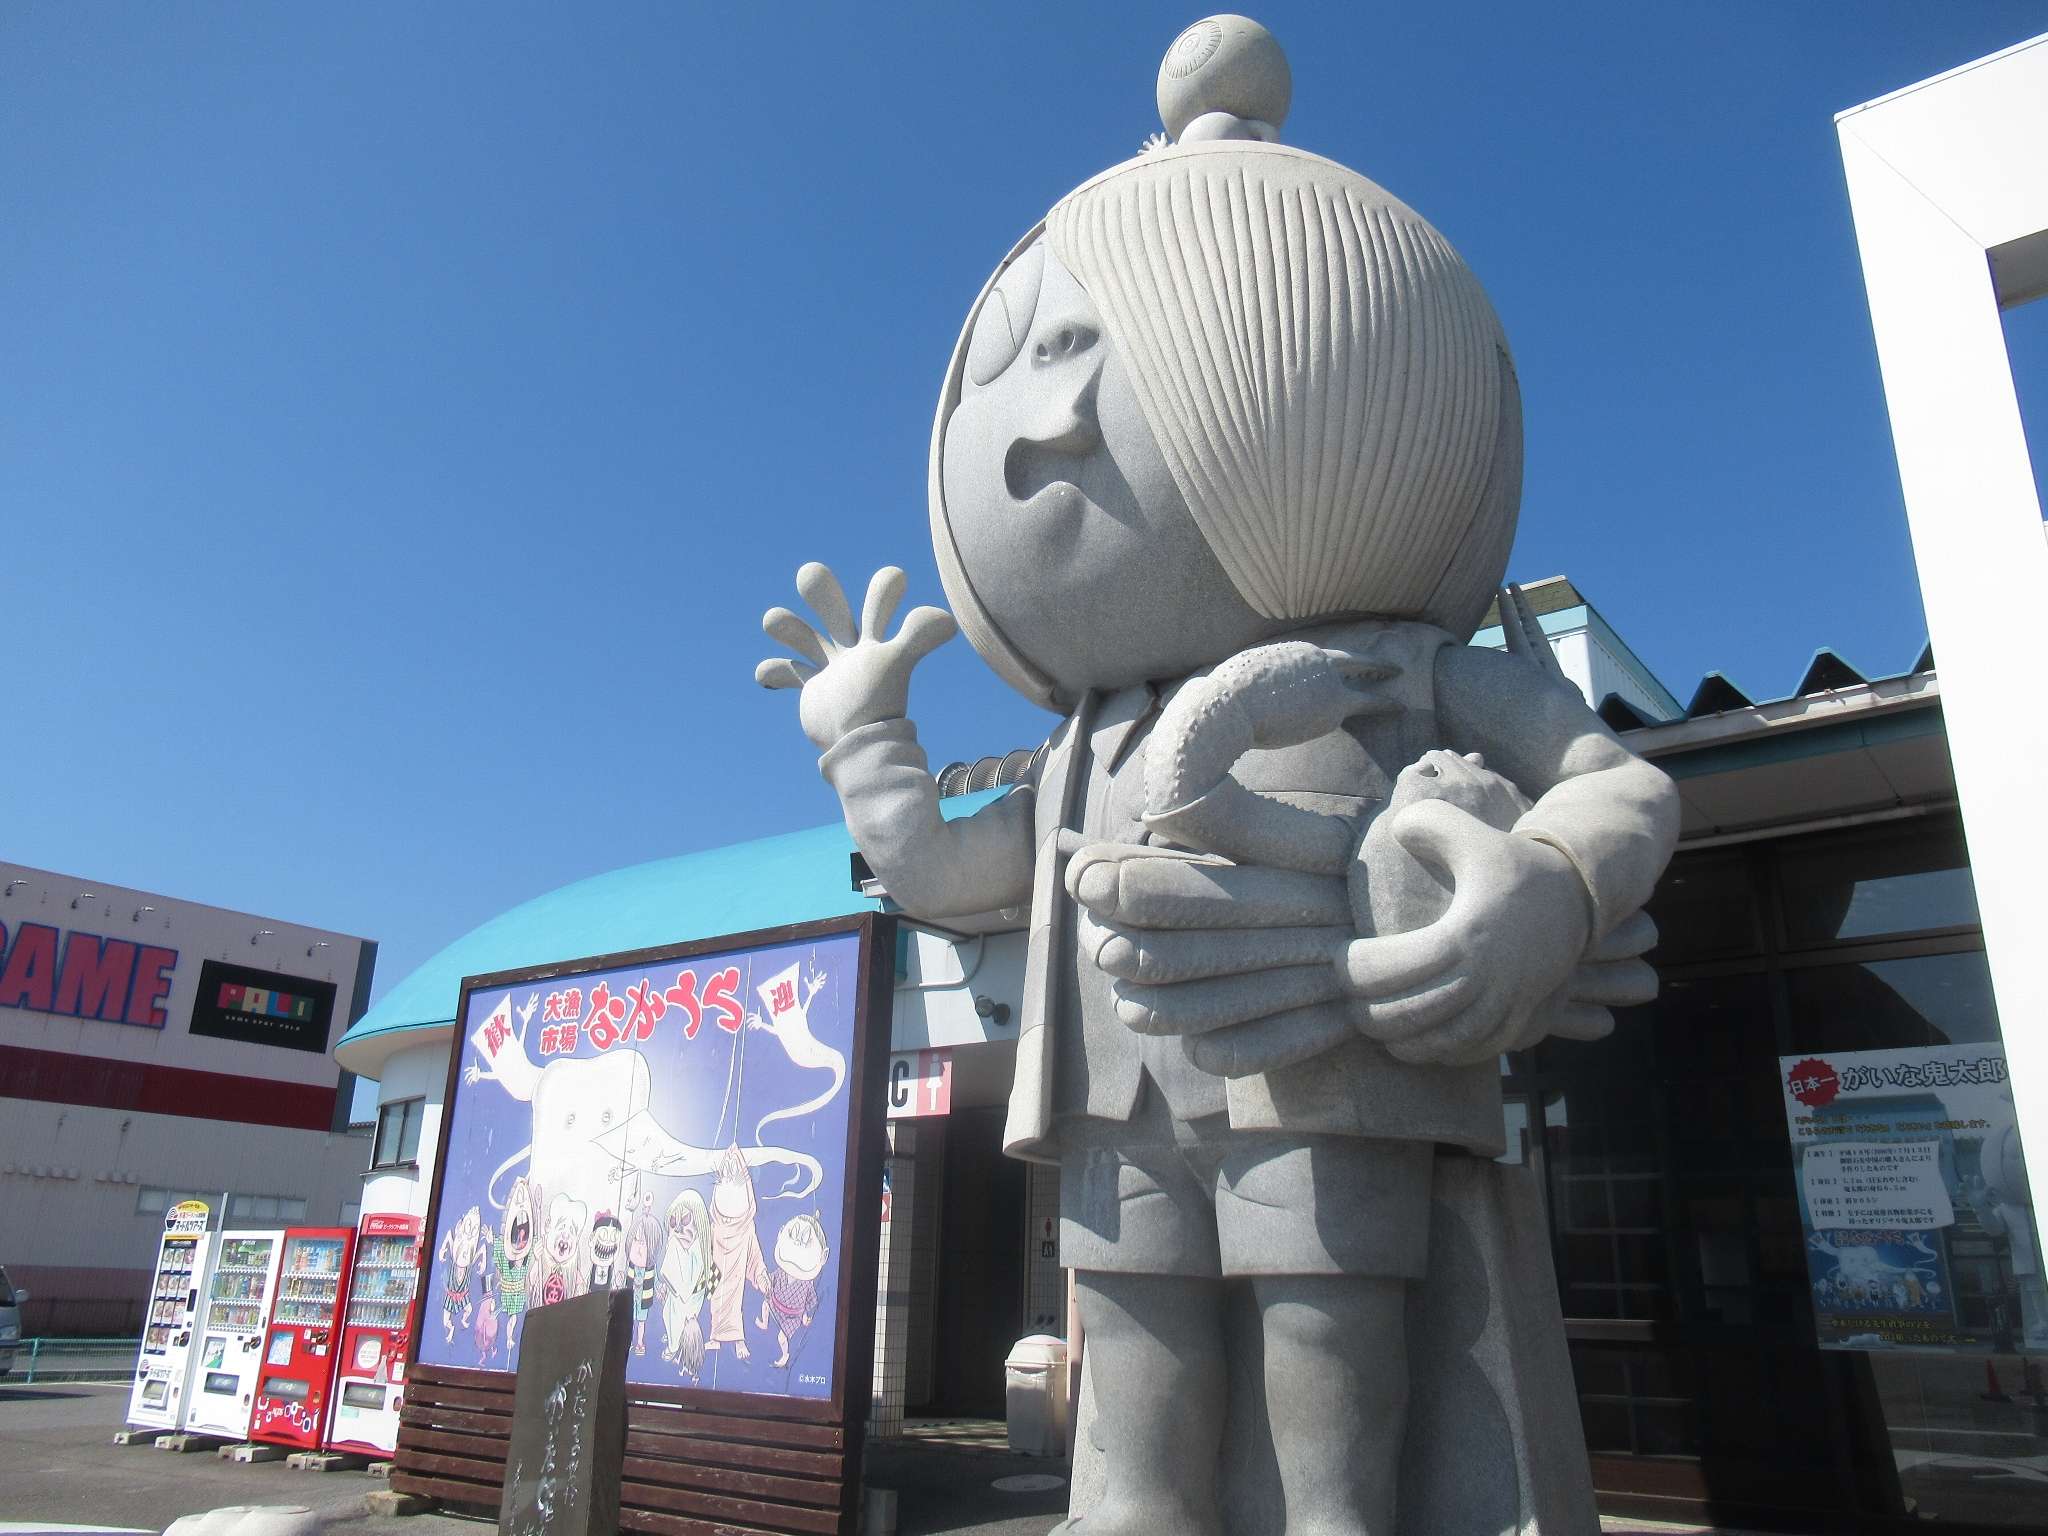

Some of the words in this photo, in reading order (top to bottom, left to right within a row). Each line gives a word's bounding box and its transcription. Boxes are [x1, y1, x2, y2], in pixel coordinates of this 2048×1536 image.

[0, 920, 180, 1030] AME
[543, 987, 582, 1022] 大漁
[582, 966, 744, 1050] なかうら
[769, 980, 796, 1017] 迎
[484, 1013, 512, 1058] 歓
[539, 1021, 579, 1056] 市場
[1789, 1076, 1836, 1096] 日本一
[1842, 1057, 2008, 1091] がいな鬼太郎
